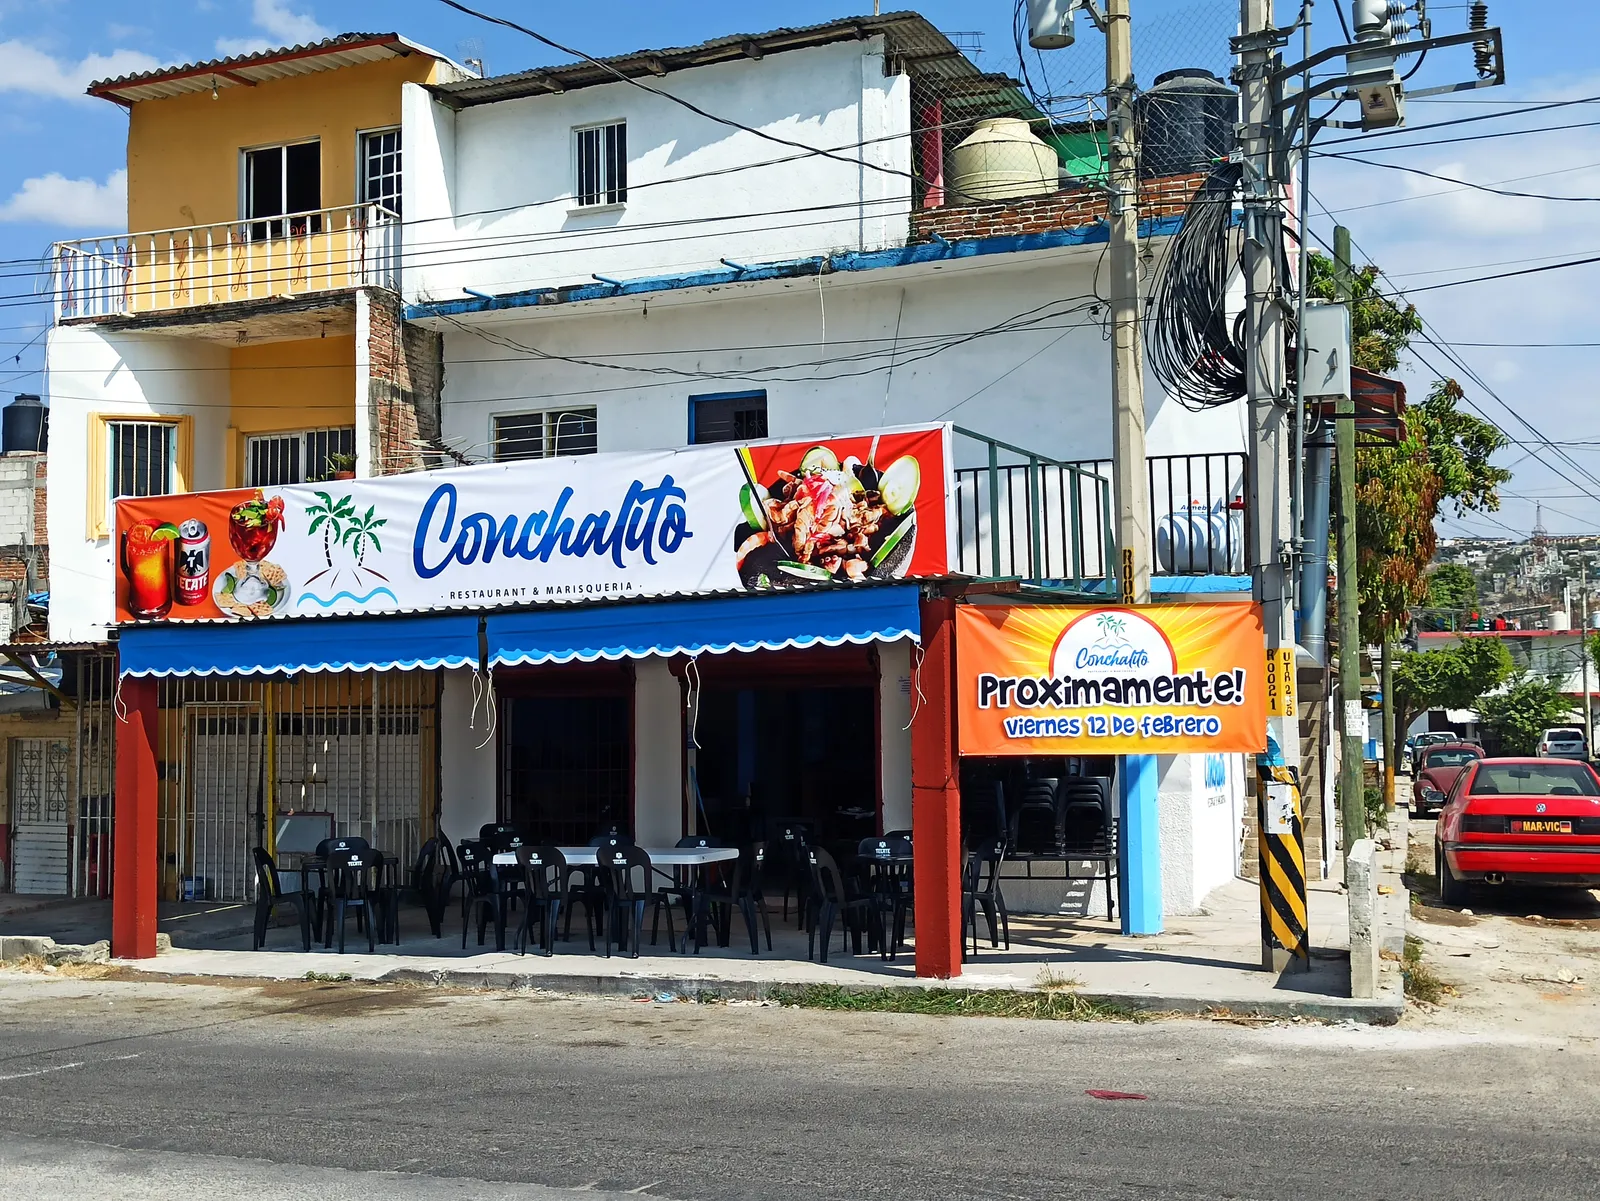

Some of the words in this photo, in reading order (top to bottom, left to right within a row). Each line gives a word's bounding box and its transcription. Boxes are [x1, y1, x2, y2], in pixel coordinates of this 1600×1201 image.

[413, 474, 693, 579] Conchalito
[450, 587, 526, 600] RESTAURANT
[532, 586, 540, 596] &
[546, 581, 632, 595] MARISQUERIA
[1075, 647, 1149, 669] Conchalito
[980, 669, 1245, 707] Proximamente!
[1087, 716, 1106, 734] 12
